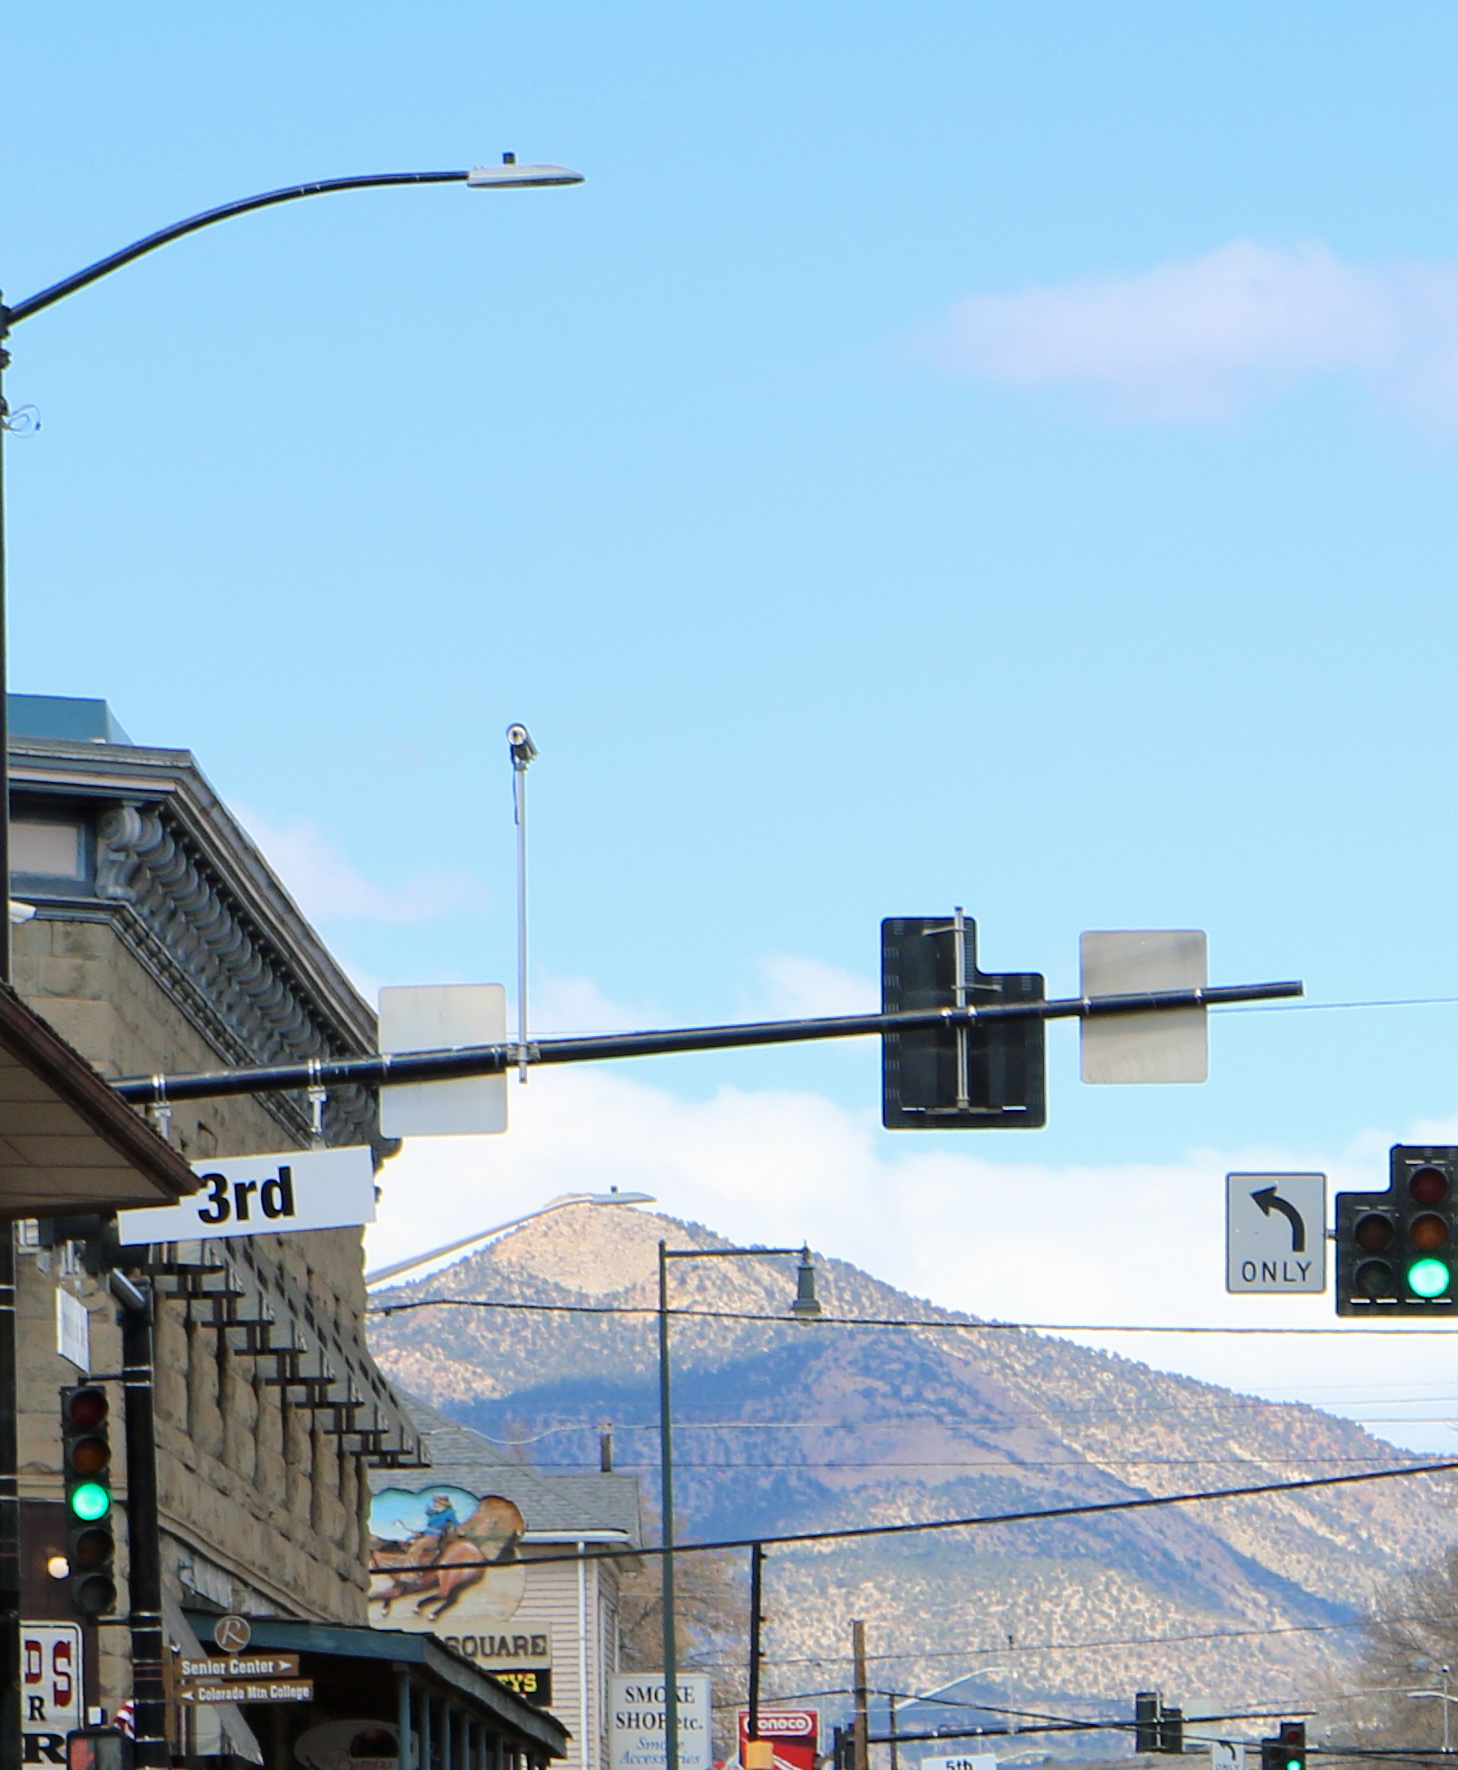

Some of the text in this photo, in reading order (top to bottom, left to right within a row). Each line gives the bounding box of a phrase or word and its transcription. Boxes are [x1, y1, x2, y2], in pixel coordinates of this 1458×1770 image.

[197, 1165, 295, 1224] 3rd
[1242, 1261, 1312, 1282] ONLY
[444, 1634, 548, 1658] SQUARE
[181, 1657, 275, 1677] Senior Center
[198, 1683, 311, 1703] Colorado Mtn College
[756, 1716, 807, 1733] onoco
[636, 1735, 685, 1752] Smoe
[619, 1750, 700, 1766] Accessies
